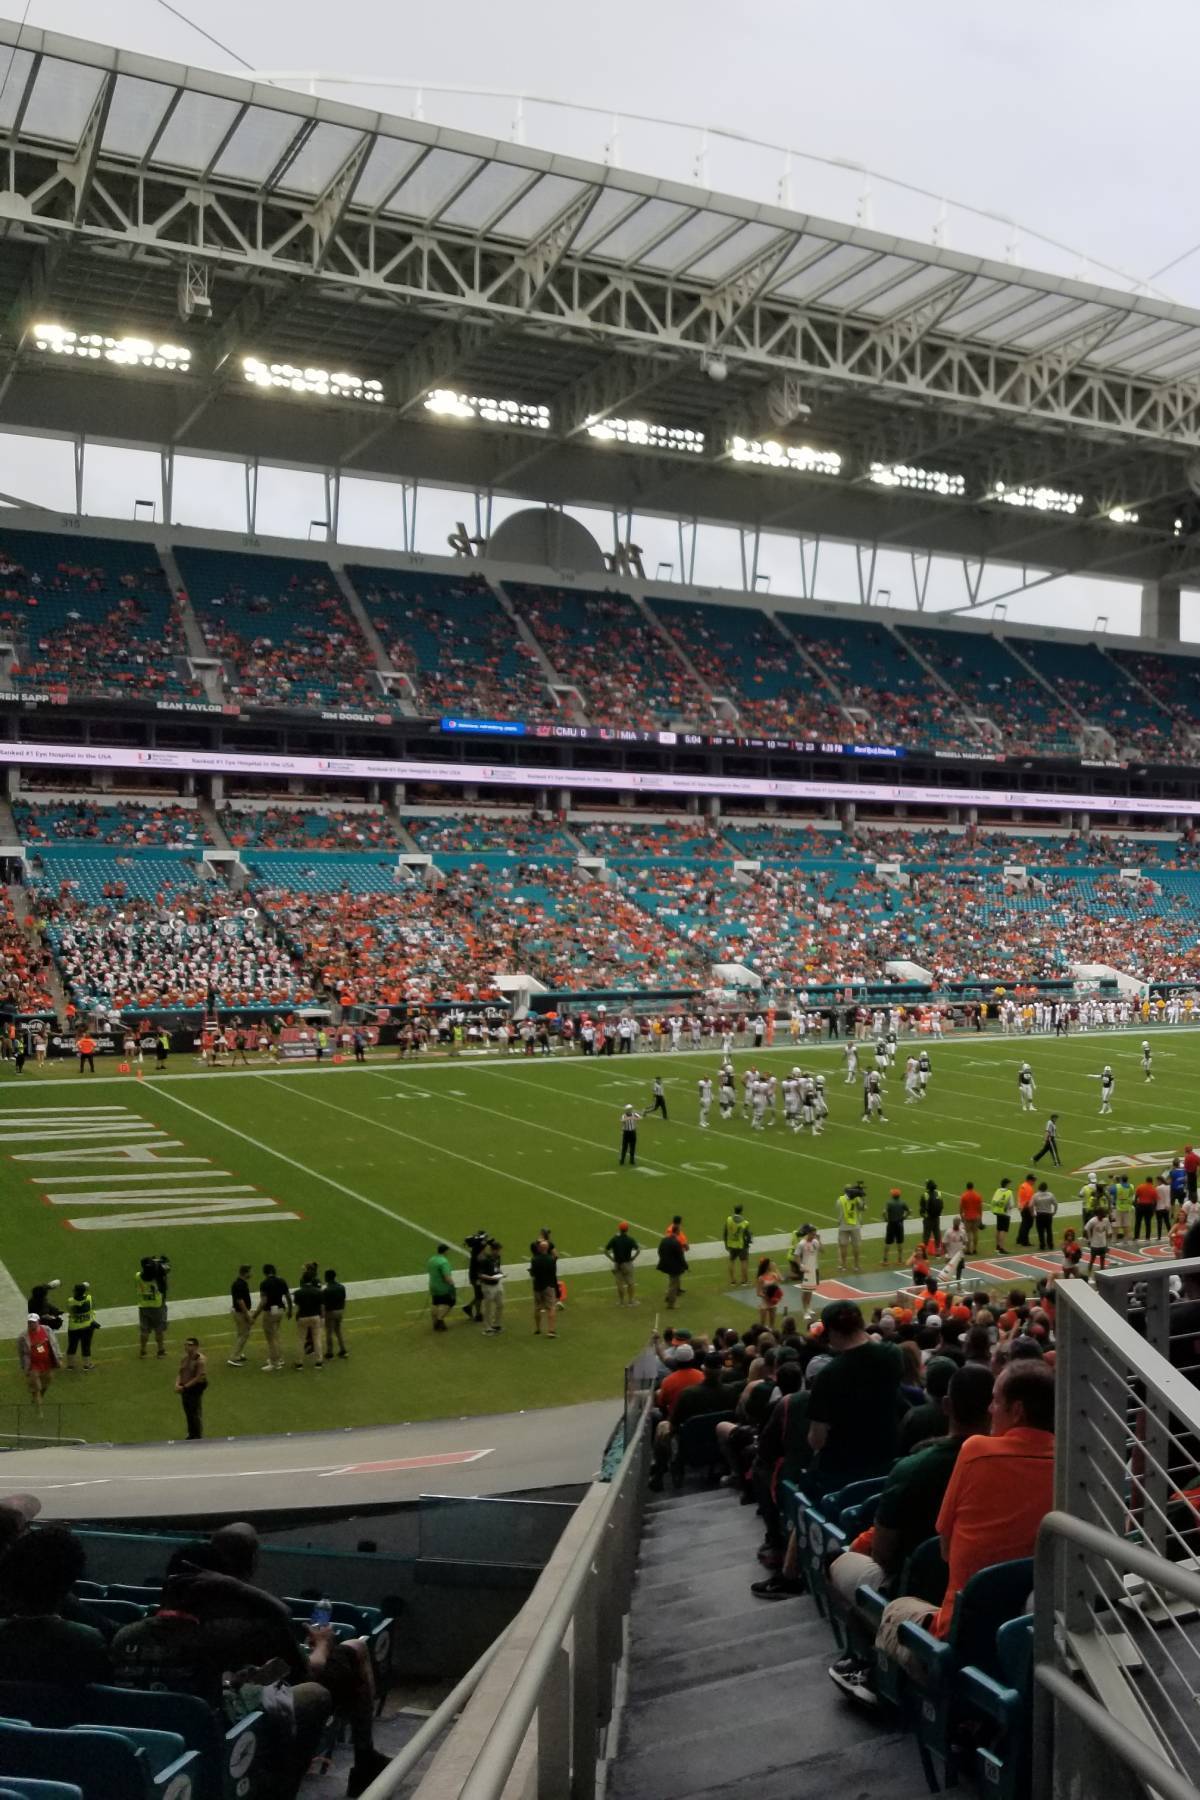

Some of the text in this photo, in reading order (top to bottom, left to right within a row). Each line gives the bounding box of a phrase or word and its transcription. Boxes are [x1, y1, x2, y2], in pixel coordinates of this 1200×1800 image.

[22, 693, 49, 703] SAPP
[157, 701, 222, 713] SEAN TAYLOR
[322, 711, 337, 720] JIM
[556, 727, 577, 737] CMU
[620, 731, 637, 740] MIA
[643, 732, 650, 741] 7
